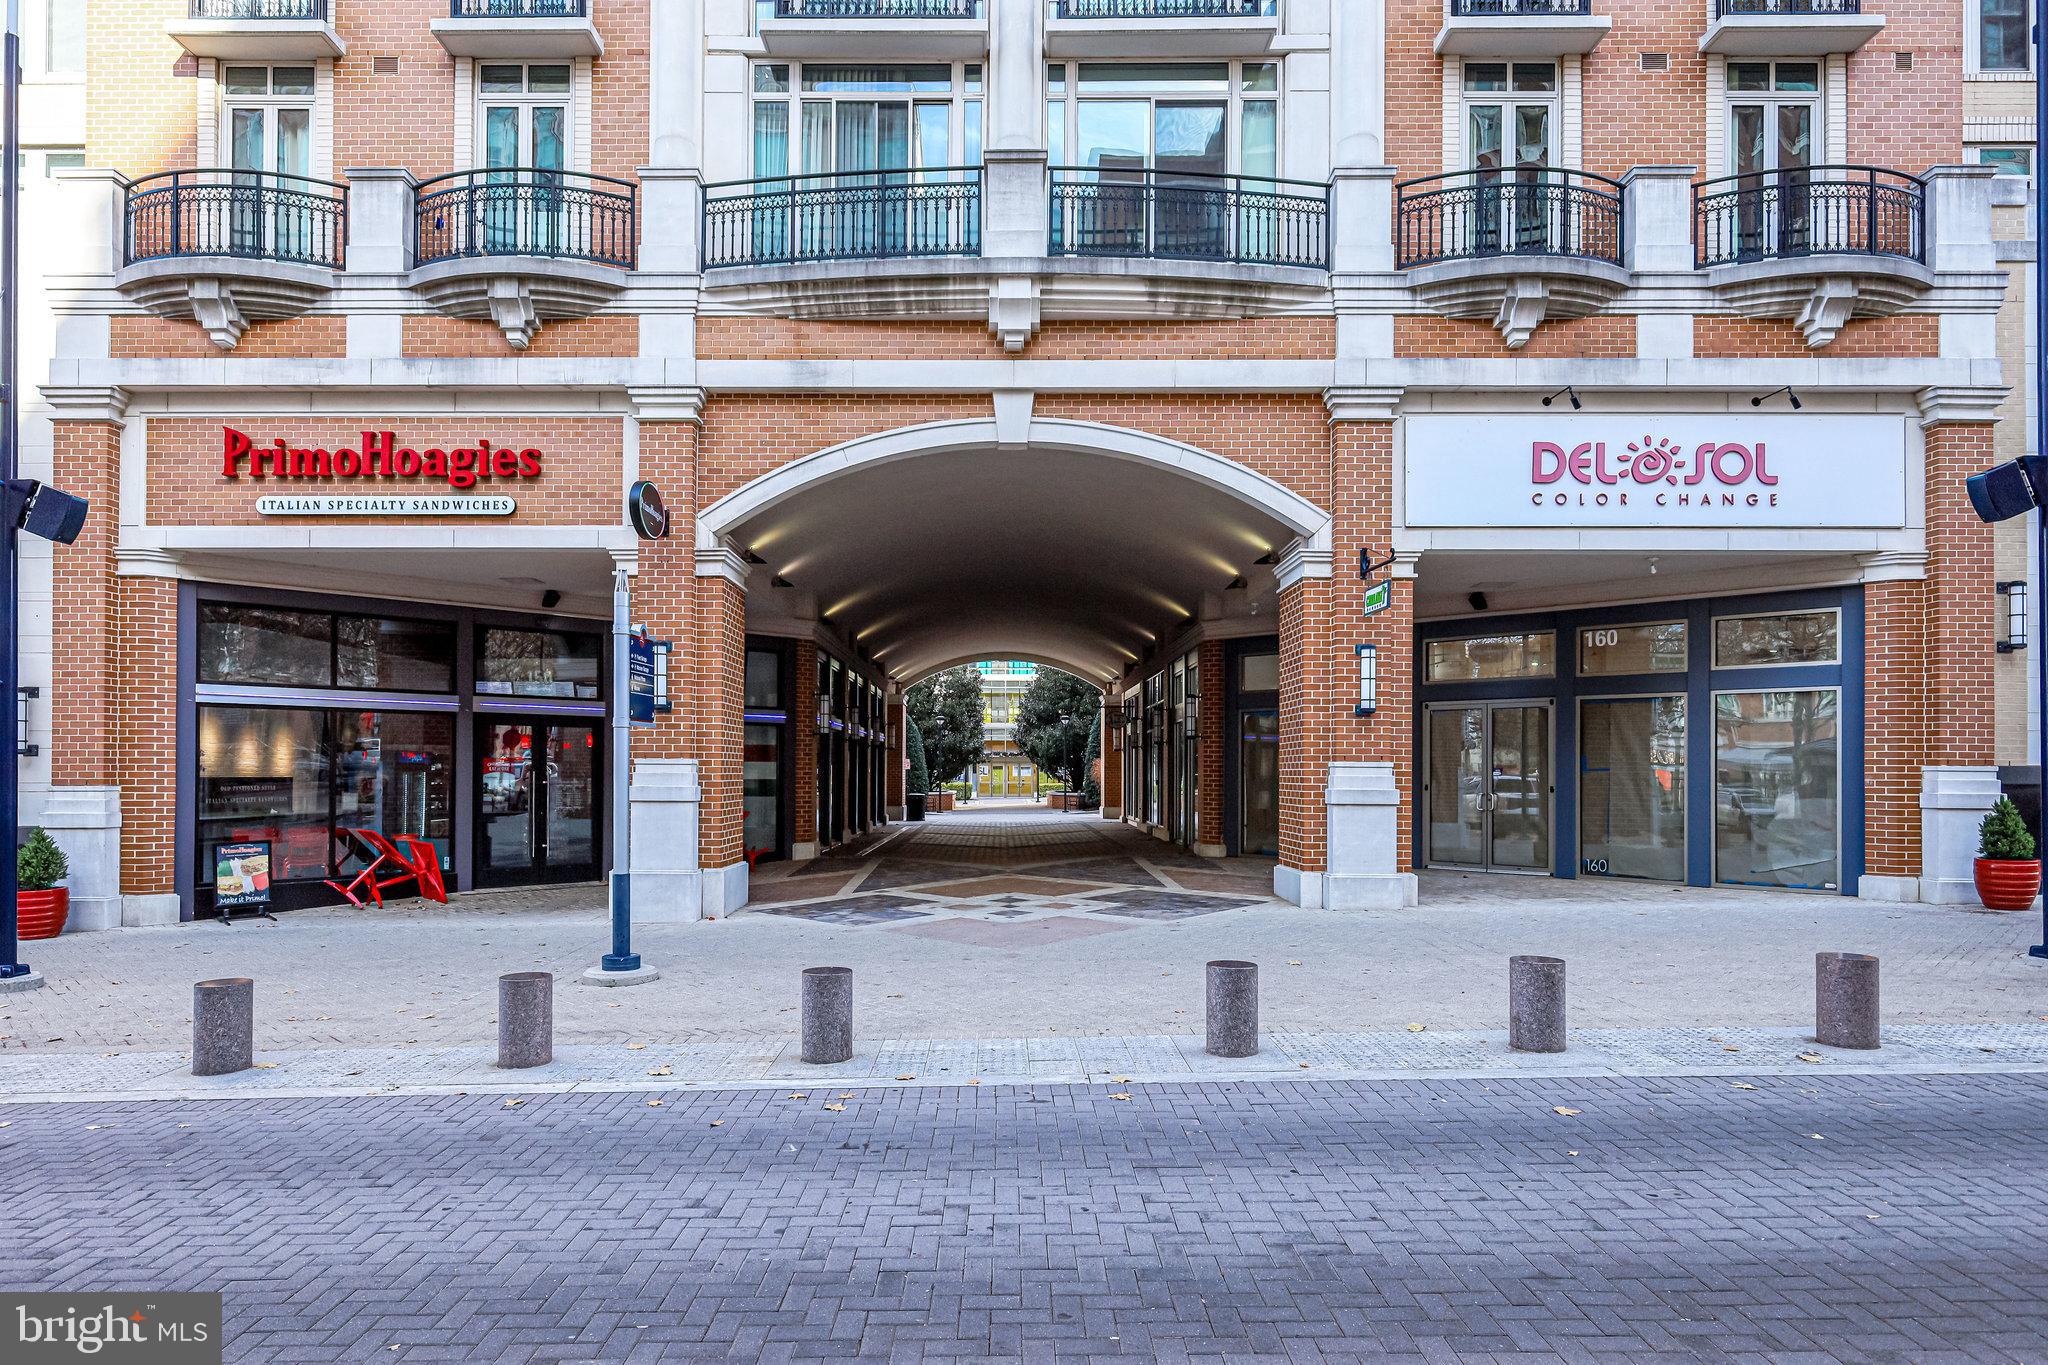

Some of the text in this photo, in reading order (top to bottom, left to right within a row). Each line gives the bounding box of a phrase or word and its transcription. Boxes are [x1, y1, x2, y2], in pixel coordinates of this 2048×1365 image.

[222, 426, 543, 488] PrimoHoagies
[1532, 441, 1779, 486] DEL SOL
[261, 500, 509, 511] ITALIAN SPECIALTY SANDWICHES
[1531, 493, 1779, 506] COLOR CHANGE
[1584, 629, 1618, 648] 160
[1585, 858, 1608, 873] 160
